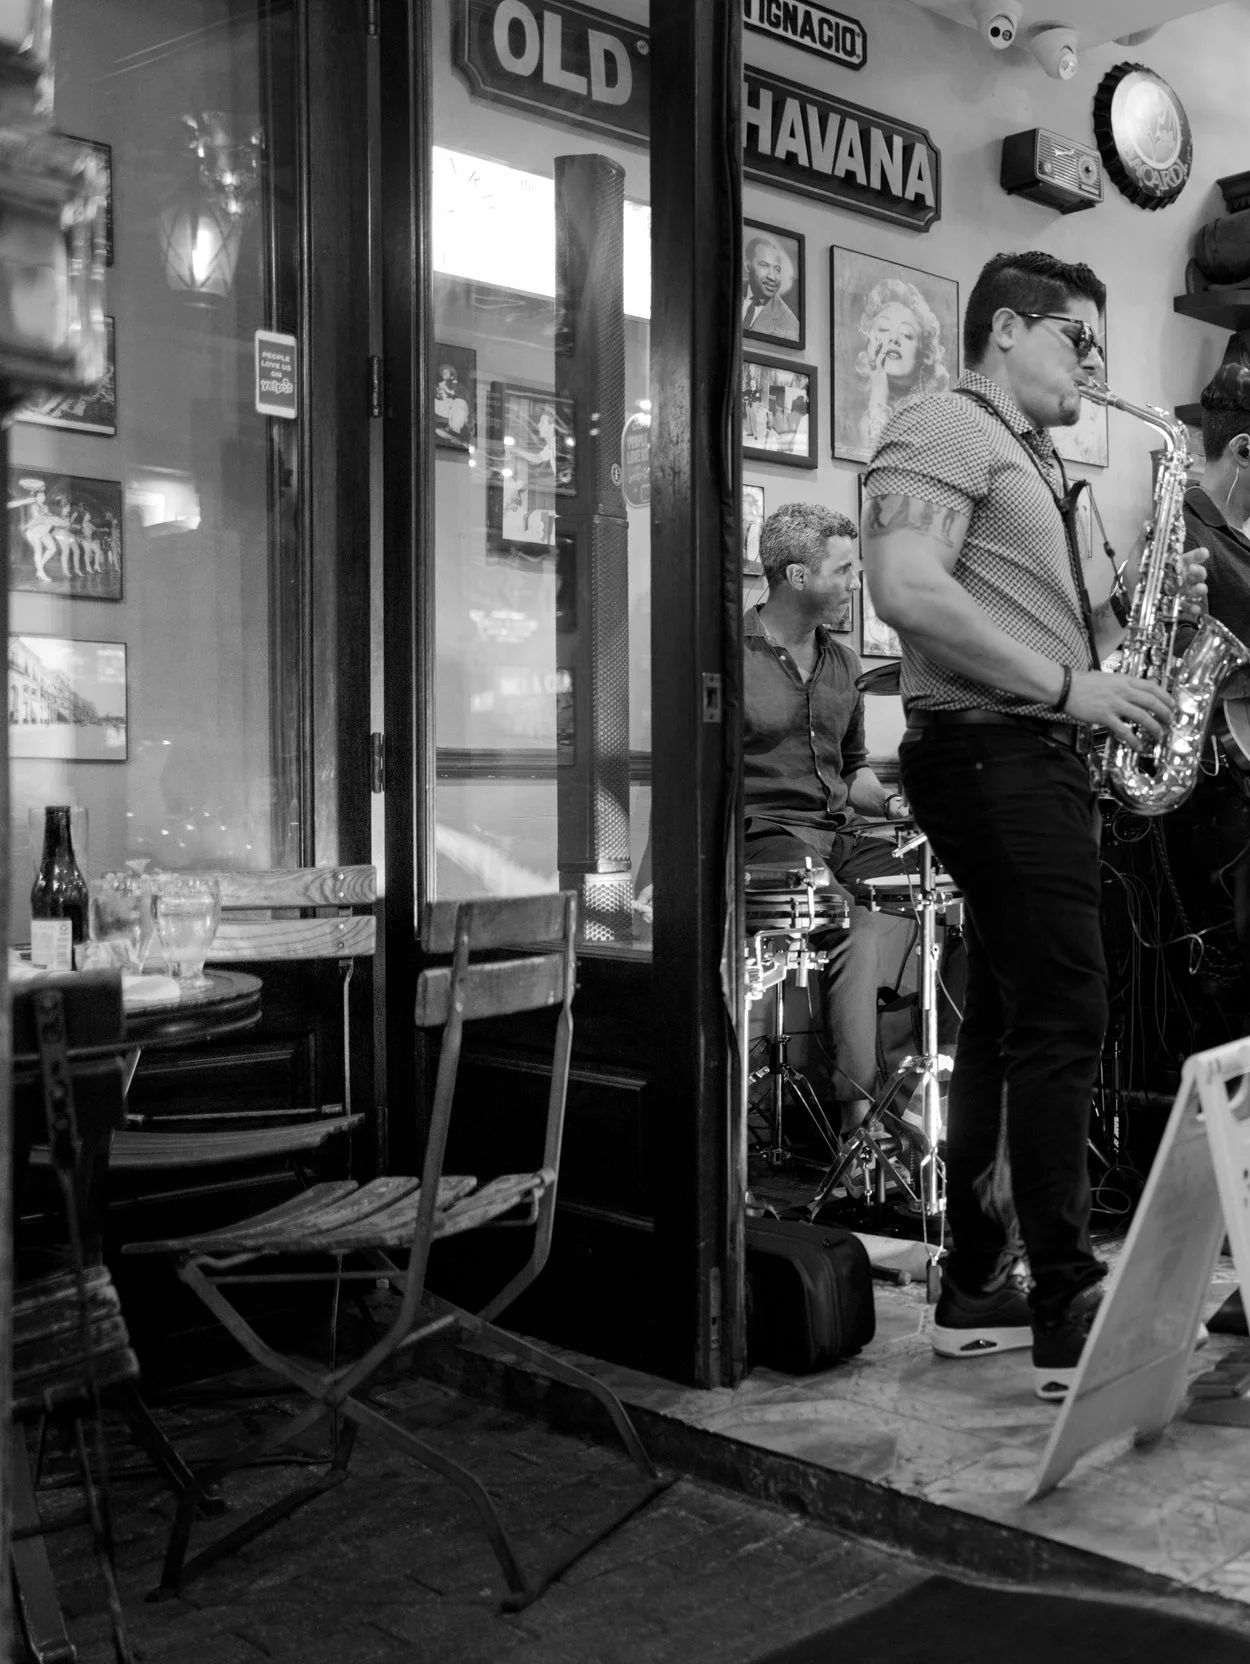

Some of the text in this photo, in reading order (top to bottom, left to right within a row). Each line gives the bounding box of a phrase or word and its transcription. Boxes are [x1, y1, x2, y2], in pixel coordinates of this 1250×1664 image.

[493, 0, 632, 106] OLD
[759, 0, 856, 58] IGNACIO
[743, 81, 935, 208] HAVANA
[261, 360, 280, 369] LOVE
[262, 351, 290, 362] PEOPLE
